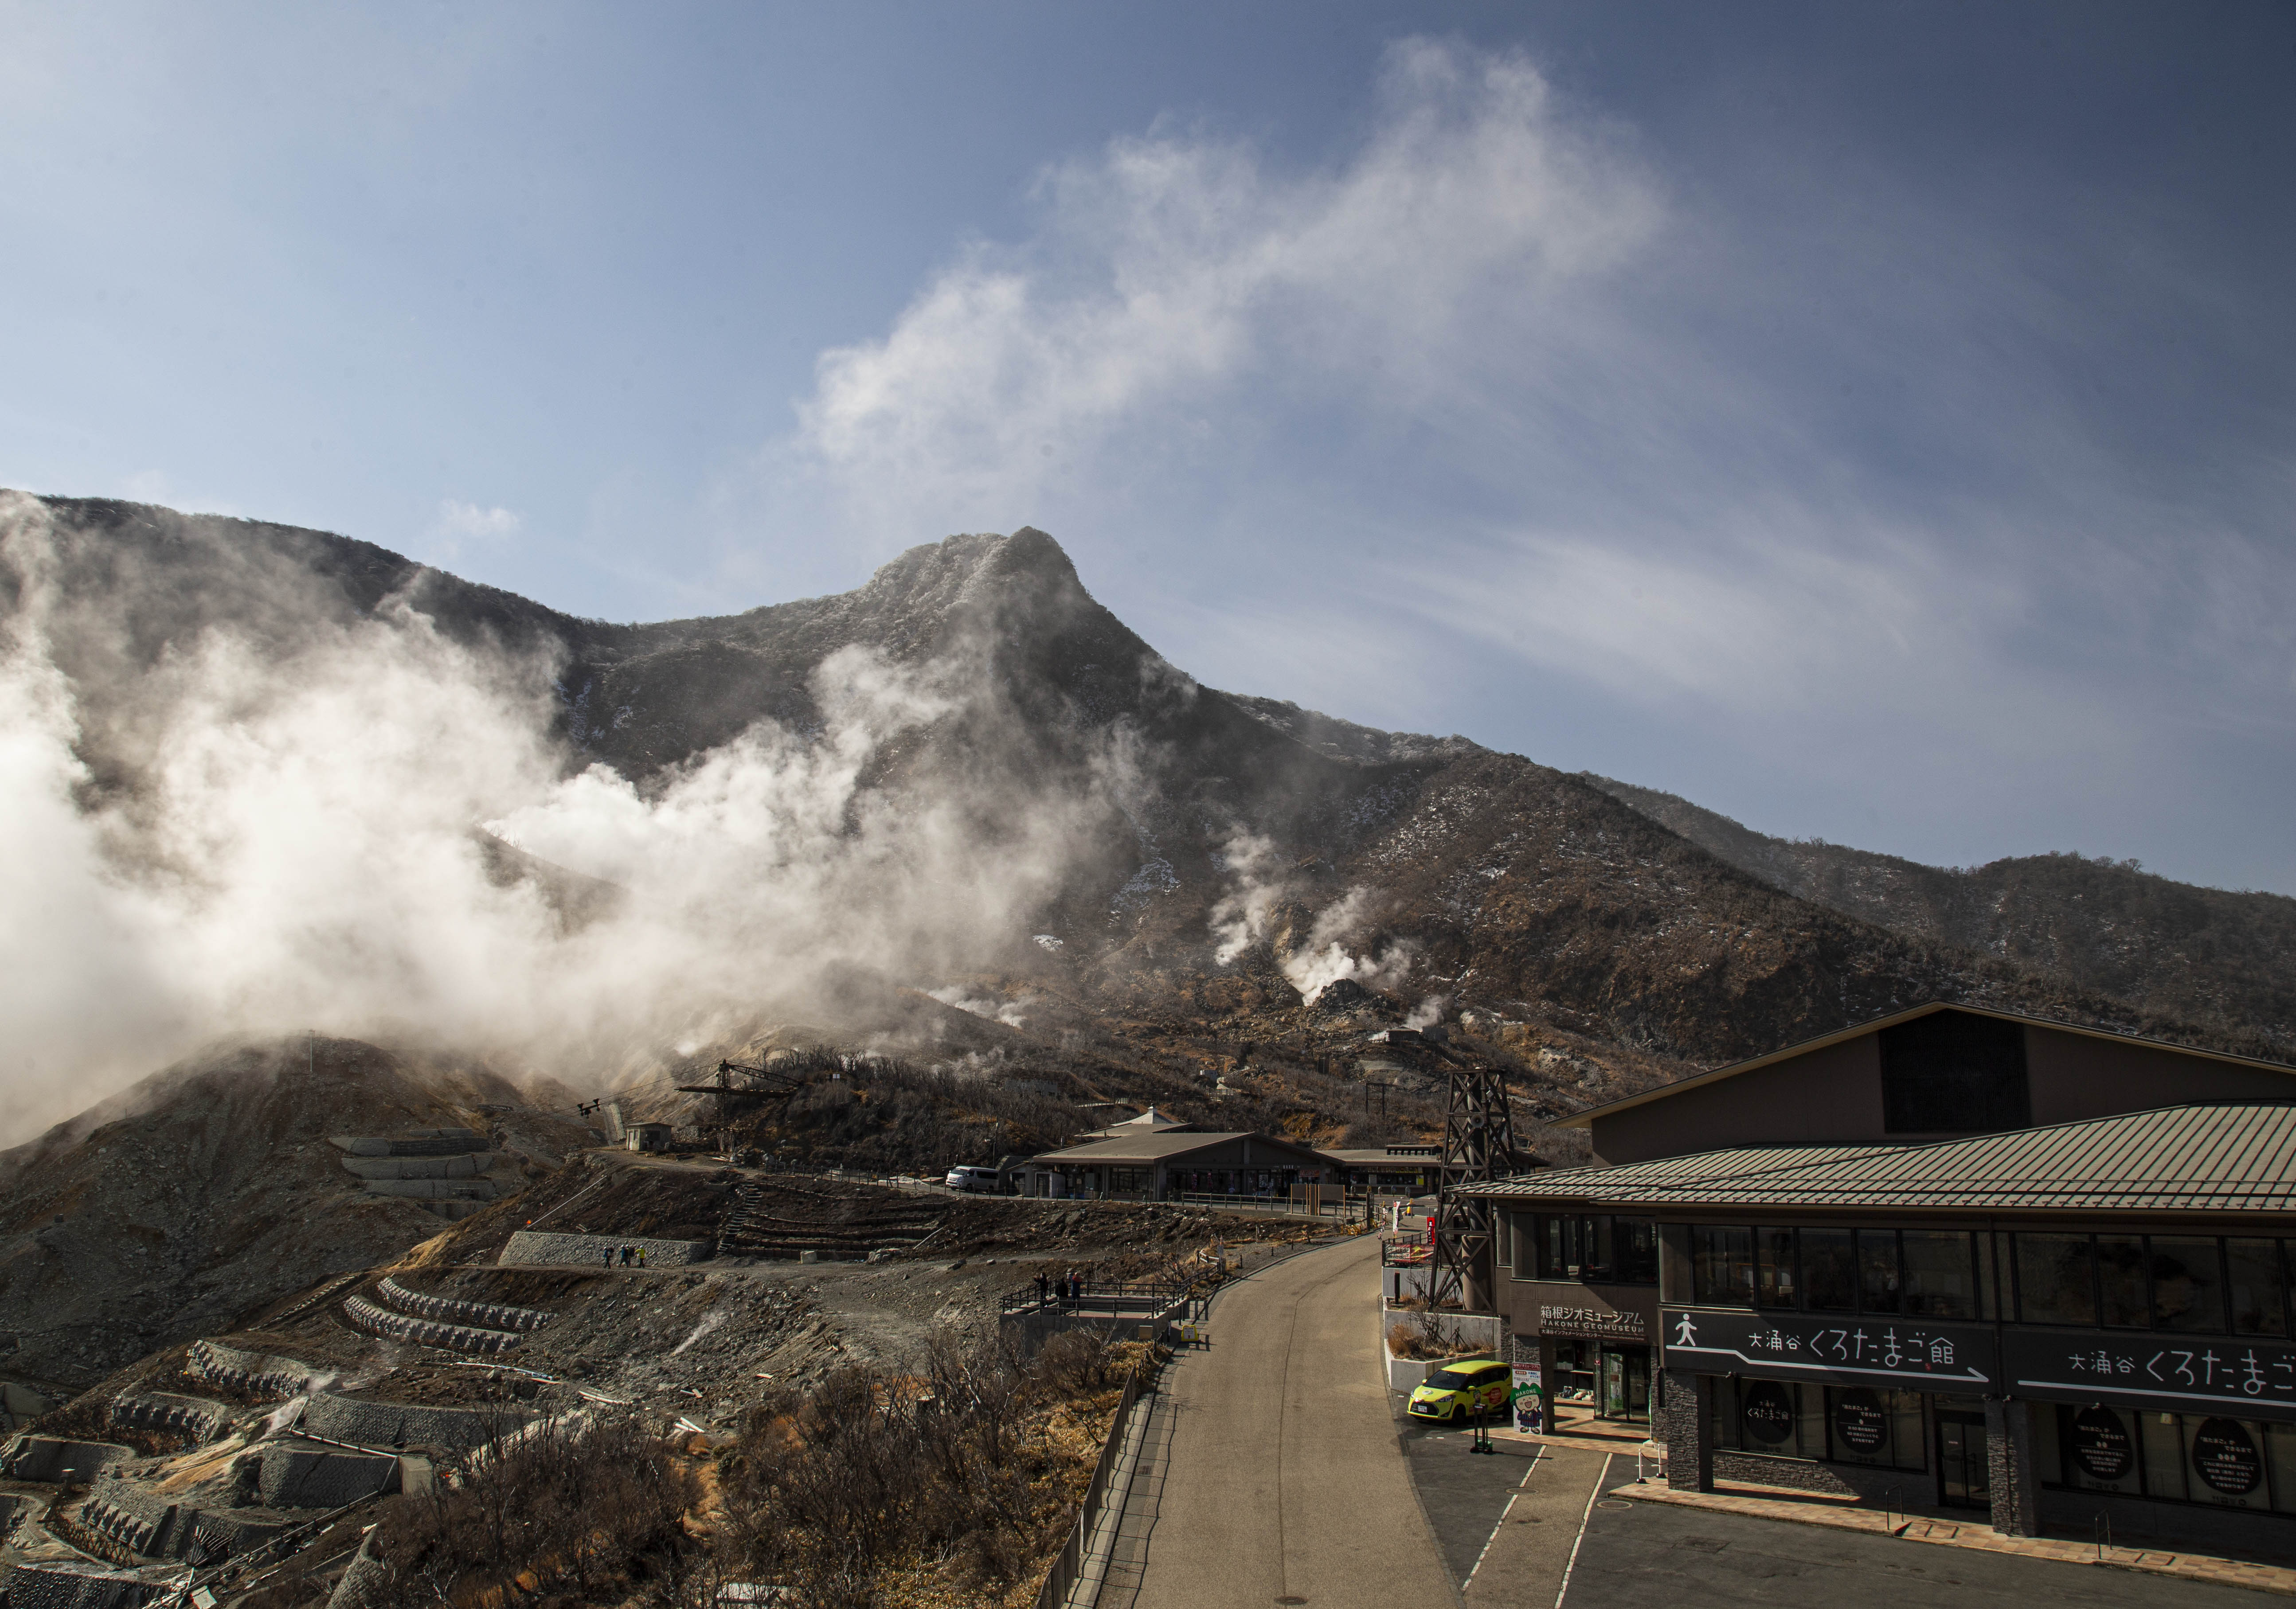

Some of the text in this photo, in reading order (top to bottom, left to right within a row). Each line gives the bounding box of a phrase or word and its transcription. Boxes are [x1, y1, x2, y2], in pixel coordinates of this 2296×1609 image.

[1541, 1305, 1644, 1324] 箱根ジオミュージアム
[1541, 1319, 1644, 1333] HAKONE GEOMUSEUM
[1748, 1327, 1954, 1367] 大涌谷 くろたまご館
[2068, 1349, 2296, 1394] 大涌谷 くろたまご
[1515, 1389, 1537, 1397] HAKONE
[1748, 1408, 1788, 1420] くろたまご館
